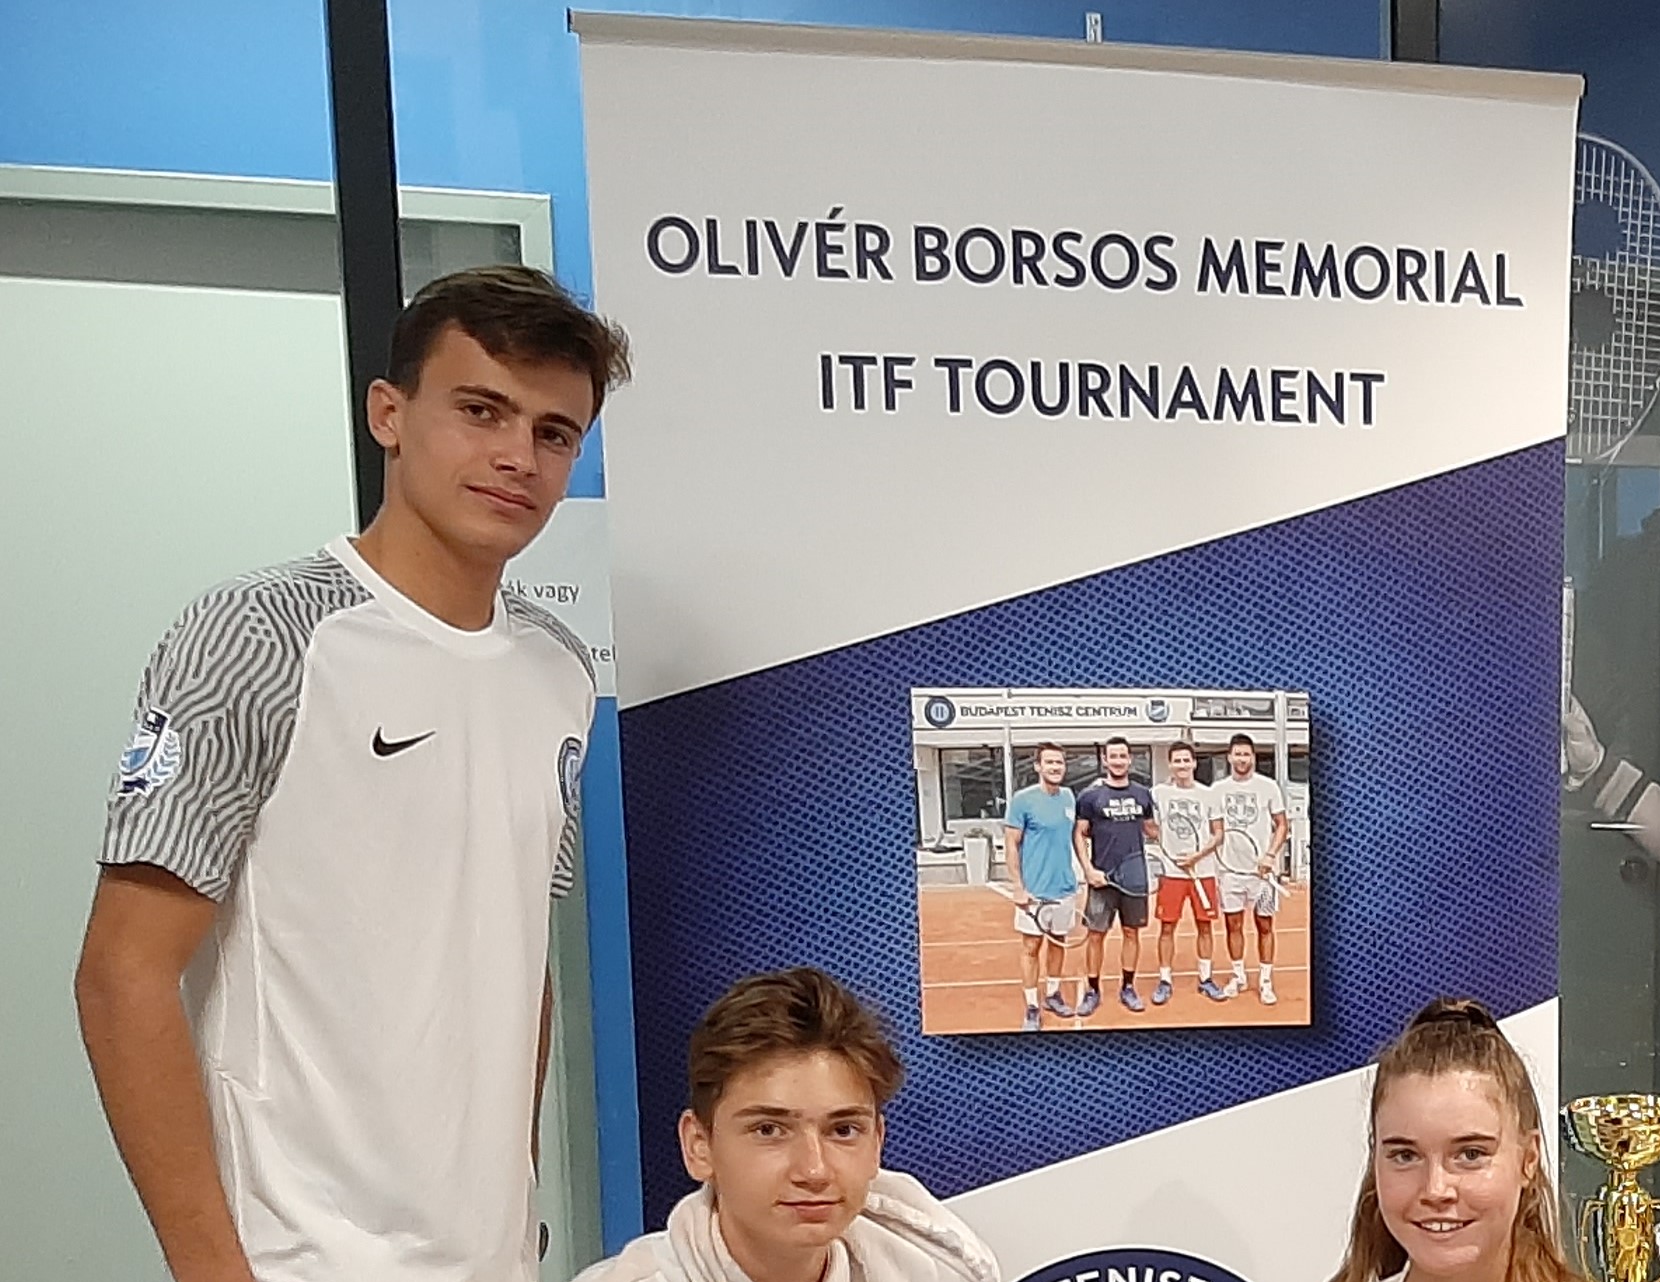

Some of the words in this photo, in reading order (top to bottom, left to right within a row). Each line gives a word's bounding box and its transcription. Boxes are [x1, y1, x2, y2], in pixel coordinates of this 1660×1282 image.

[646, 206, 894, 281] OLIVÉR
[914, 225, 1178, 292] BORSOS
[1197, 237, 1523, 307] MEMORIAL
[820, 354, 916, 411] ITF
[934, 357, 1385, 425] TOURNAMENT
[533, 585, 579, 604] vagy
[960, 705, 1026, 718] BUDAPEST
[1030, 706, 1073, 718] TENISZ
[1076, 706, 1138, 718] CENTRUM
